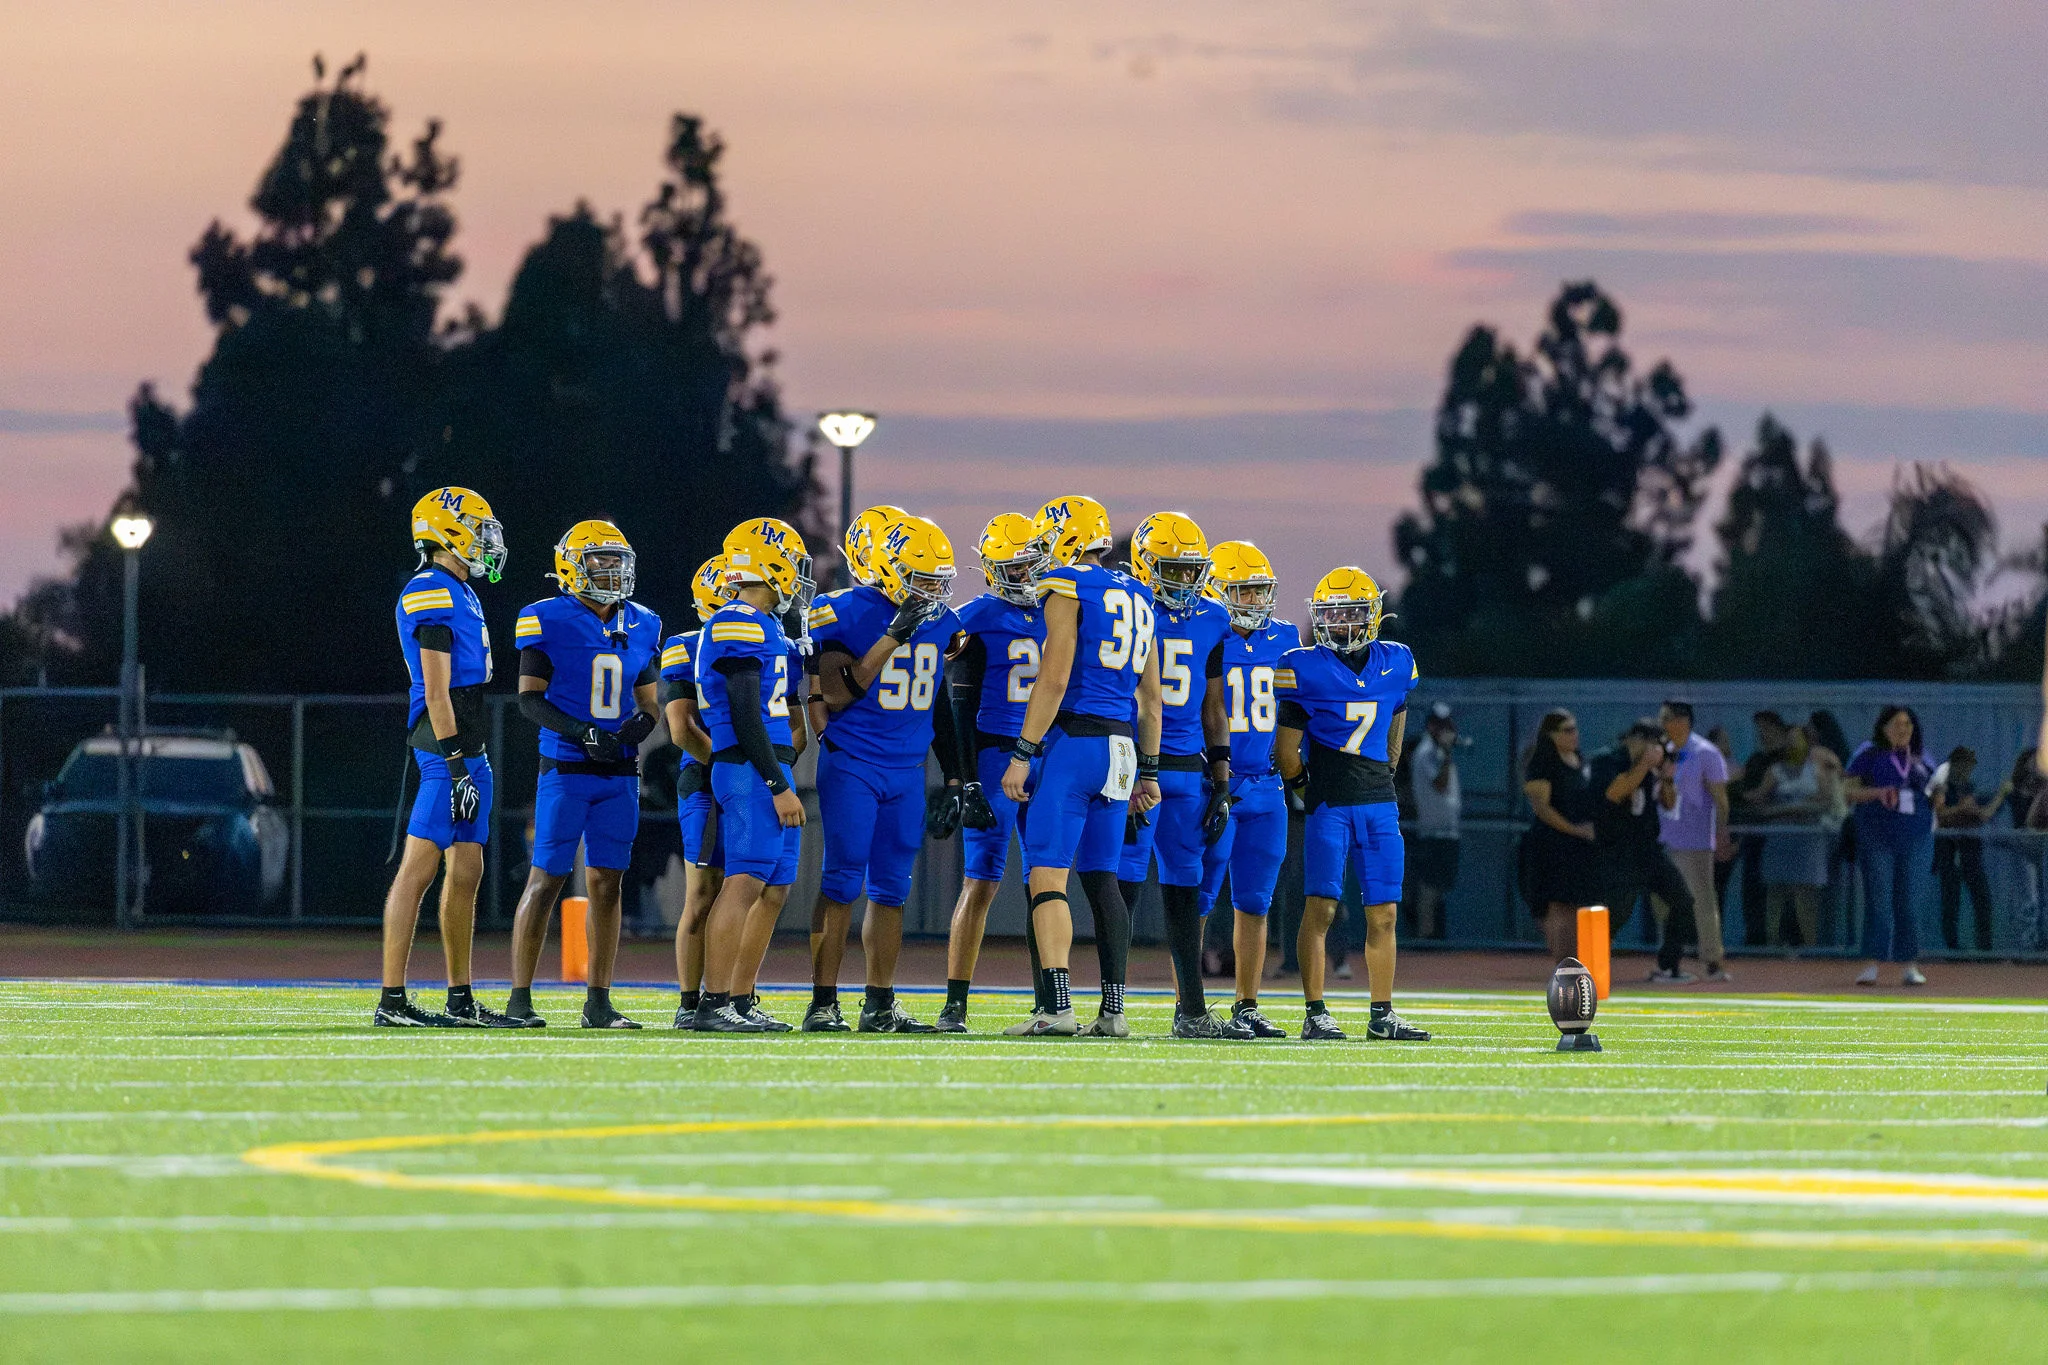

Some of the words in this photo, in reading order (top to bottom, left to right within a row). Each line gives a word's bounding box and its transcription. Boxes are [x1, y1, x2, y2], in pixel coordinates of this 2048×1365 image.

[438, 488, 465, 512] LM
[1044, 502, 1072, 523] LM
[760, 521, 786, 550] LM
[886, 522, 911, 555] LM
[1098, 588, 1155, 674] 38
[590, 653, 623, 719] 0
[878, 642, 938, 711] 58
[1007, 637, 1047, 702] 2
[1160, 638, 1193, 706] 5
[1226, 666, 1277, 733] 18
[1339, 701, 1378, 756] 7
